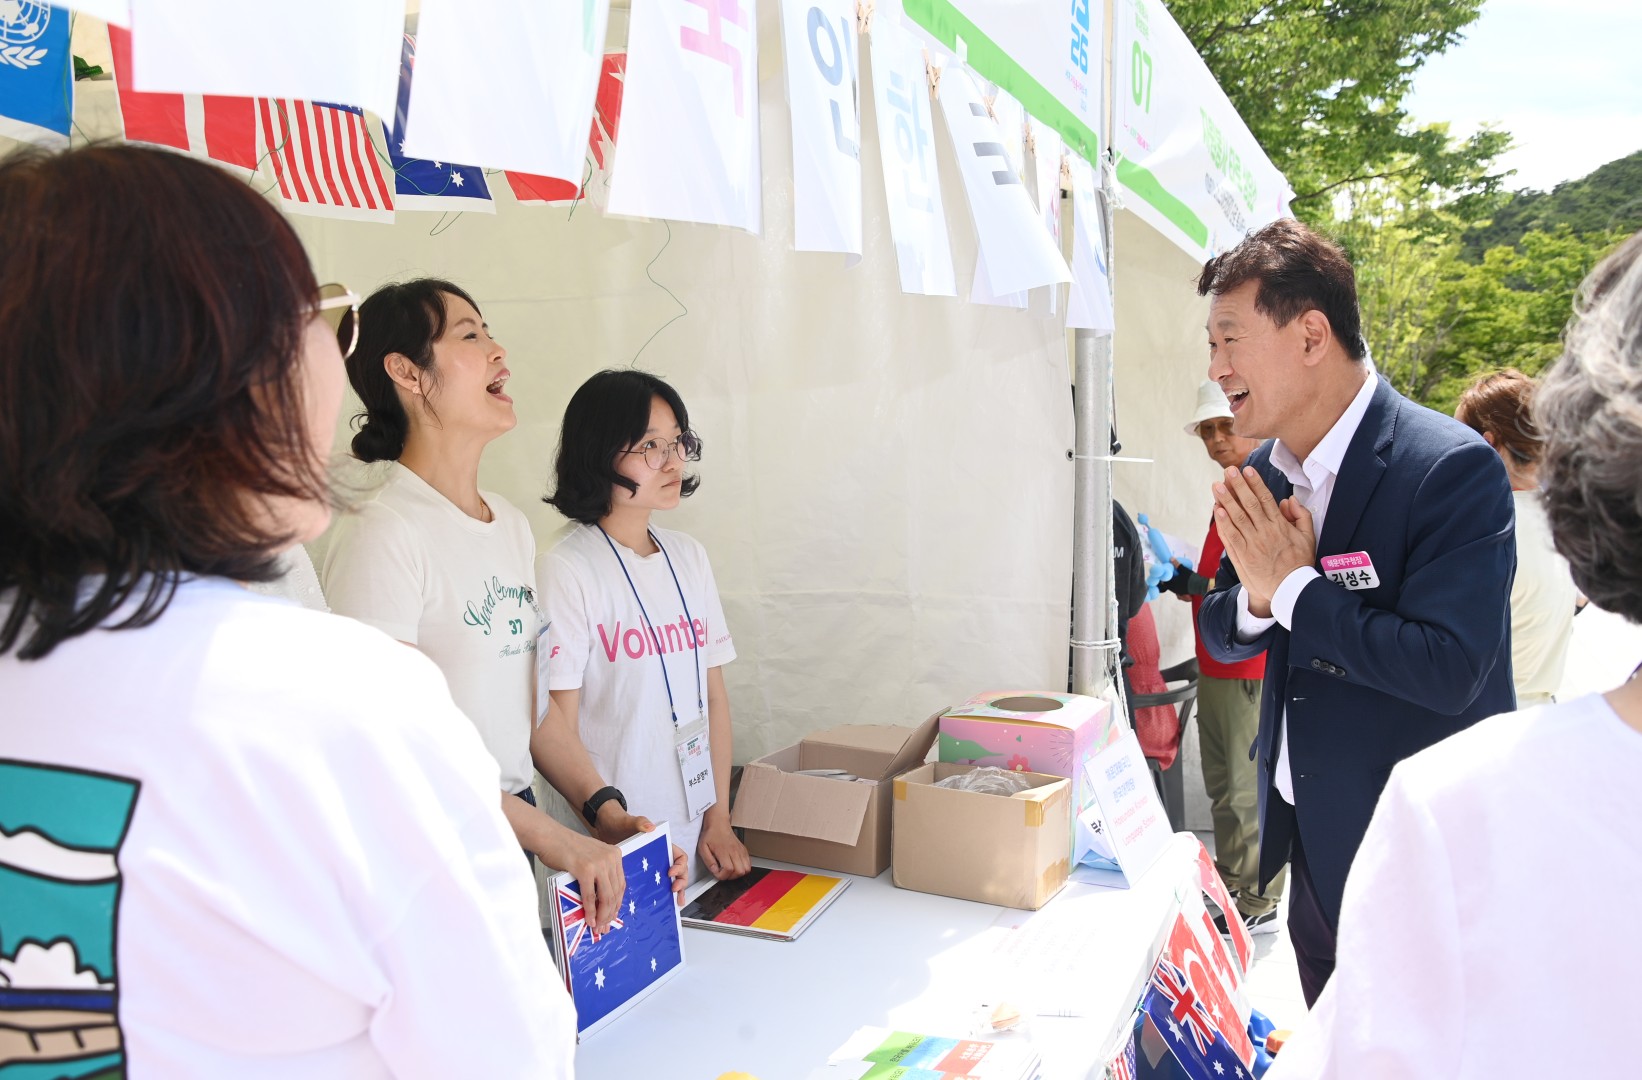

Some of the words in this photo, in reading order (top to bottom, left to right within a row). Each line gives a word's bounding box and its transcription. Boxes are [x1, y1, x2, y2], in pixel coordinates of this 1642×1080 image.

[1131, 40, 1153, 114] 07
[1326, 556, 1363, 568] 해운대구청장
[1331, 570, 1372, 588] 김성수
[463, 579, 496, 636] Good
[508, 618, 523, 636] 37
[597, 614, 709, 662] Volunte
[1122, 826, 1144, 846] Language
[1141, 812, 1157, 829] School
